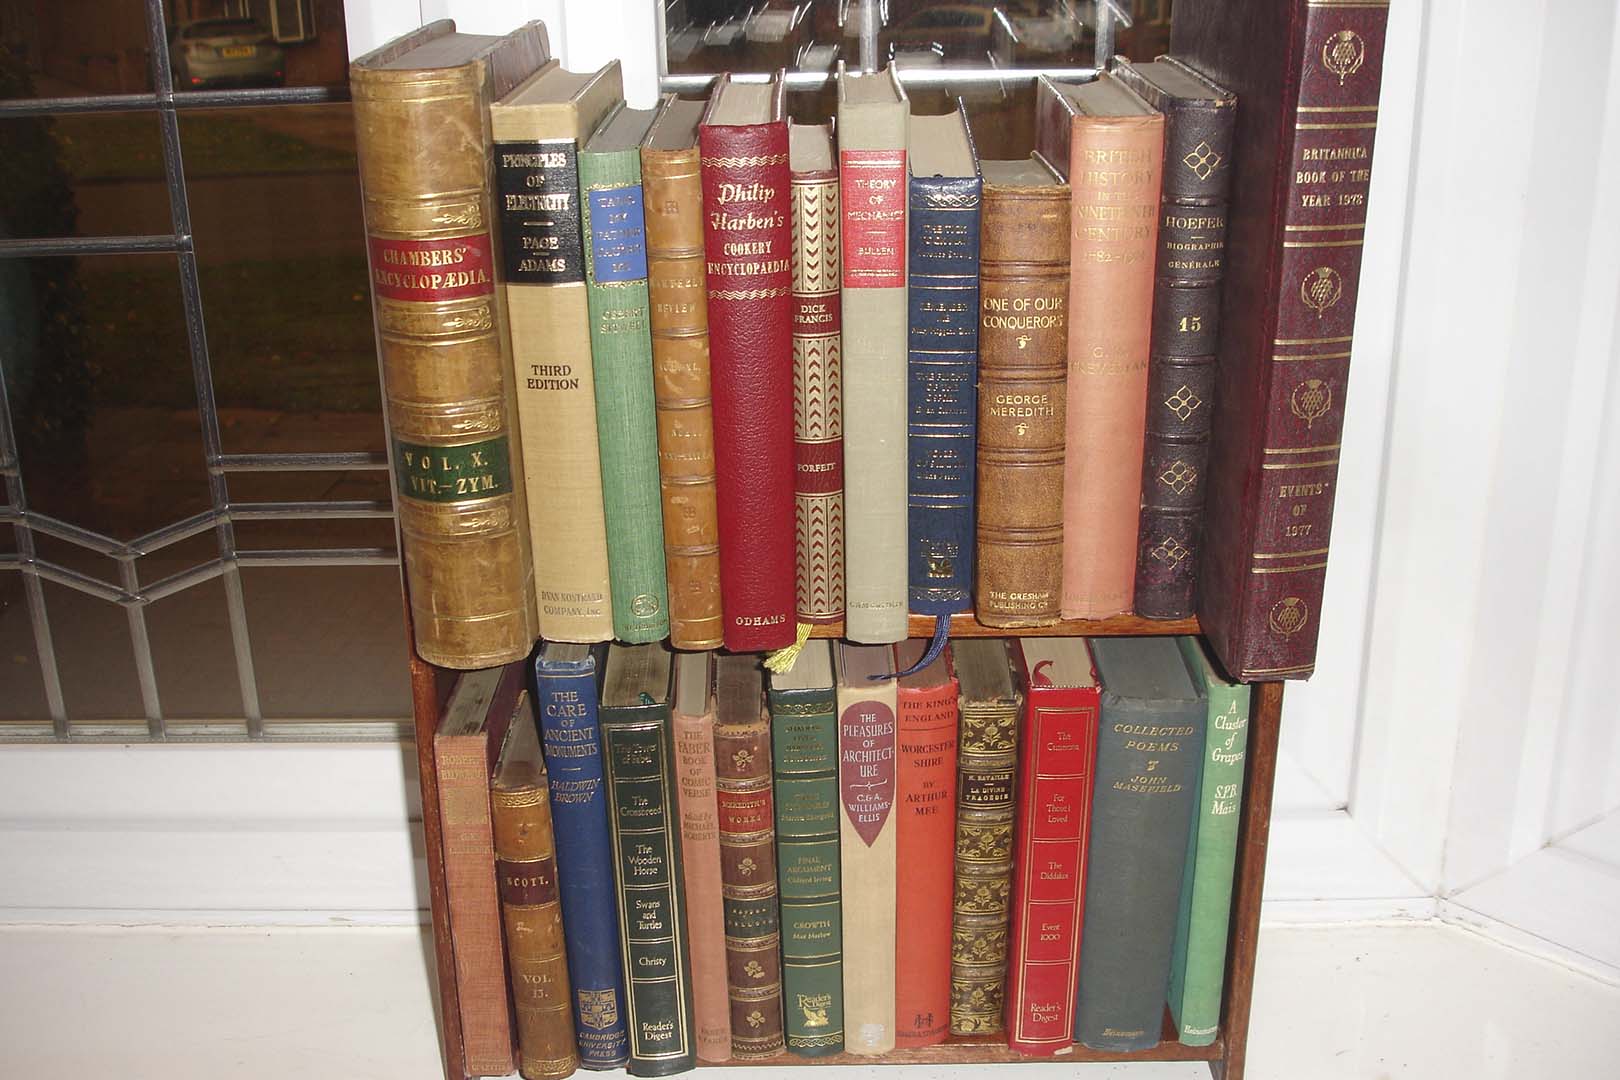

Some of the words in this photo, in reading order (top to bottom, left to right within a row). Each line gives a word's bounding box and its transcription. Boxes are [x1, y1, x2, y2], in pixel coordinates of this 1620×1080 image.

[1303, 147, 1368, 161] BRITANNICA
[502, 153, 567, 168] PRINCIPLES
[526, 175, 545, 188] OF
[1296, 170, 1327, 184] BOOK
[1331, 170, 1345, 183] OF
[1350, 169, 1369, 182] THE
[855, 179, 897, 189] THEORY
[717, 183, 774, 204] Philip
[505, 193, 570, 211] ELECTRICITY
[868, 195, 884, 205] OF
[1302, 194, 1331, 207] YEAR
[1338, 193, 1363, 206] 1978
[711, 210, 784, 231] Harben's
[848, 210, 905, 221] MECHANICS
[1166, 216, 1224, 230] HOEFER
[522, 237, 559, 250] PAGE
[724, 240, 772, 256] COOKERY
[383, 248, 469, 267] CHAMBERS'
[518, 259, 566, 272] ADAMS
[707, 259, 790, 276] ENCYCLOPAEDIA
[801, 304, 826, 313] DICK
[984, 297, 1009, 312] ONE
[1013, 298, 1031, 312] OF
[1034, 297, 1063, 311] OUR
[795, 313, 833, 324] FRANCIS
[983, 314, 1063, 329] CONQUERORS
[1179, 316, 1201, 332] 15
[531, 364, 572, 377] THIRD
[527, 378, 579, 390] EDITION
[996, 394, 1048, 405] GEORGE
[990, 406, 1054, 417] MEREDITH
[471, 450, 488, 468] X.
[797, 462, 836, 472] FORFEIT
[1292, 504, 1307, 517] OF
[1285, 524, 1312, 537] 1977
[989, 591, 1007, 600] THE
[1010, 591, 1049, 600] GRESHAM
[989, 601, 1036, 610] PUBLISHING
[736, 614, 786, 627] ODHAMS
[552, 691, 579, 703] THE
[546, 703, 588, 718] CARE
[903, 701, 922, 710] THE
[1228, 699, 1238, 714] A
[860, 713, 876, 723] THE
[905, 711, 954, 723] ENGLAND
[1214, 715, 1248, 731] Cluster
[561, 719, 575, 728] OF
[544, 727, 594, 743] ANCIENT
[843, 722, 894, 738] PLEASURES
[1113, 723, 1194, 737] COLLECTED
[862, 740, 876, 748] OF
[901, 740, 955, 754] WORCESTER
[1125, 740, 1180, 752] POEMS
[1224, 732, 1238, 750] of
[545, 743, 598, 758] MONUMENTS
[679, 743, 711, 754] FABER
[913, 757, 944, 768] SHIRE
[1211, 748, 1246, 766] Grapes
[859, 765, 879, 778] URE
[551, 777, 601, 791] BALDWIN
[923, 781, 934, 789] BY
[1130, 775, 1168, 784] JOHN
[683, 788, 710, 798] VERSE
[1113, 781, 1183, 793] MASEFIELD
[555, 791, 595, 803] BROWN
[905, 791, 948, 803] ARTHUR
[1053, 793, 1065, 802] For
[914, 806, 938, 816] MEE
[1211, 801, 1237, 815] Mais
[858, 813, 880, 823] ELLIS
[1047, 815, 1068, 824] Loved
[635, 844, 653, 854] The
[627, 855, 662, 865] Wooden
[1048, 862, 1063, 870] The
[634, 865, 658, 876] Horse
[636, 900, 661, 910] Swans
[642, 910, 656, 920] and
[636, 920, 662, 930] Turtles
[1041, 923, 1060, 932] Event
[1040, 932, 1061, 941] 1000
[639, 956, 667, 967] Christy
[1031, 1002, 1061, 1013] Reader's
[1032, 1012, 1059, 1024] Digest
[642, 1021, 674, 1032] Reader's
[580, 1030, 625, 1041] CAMBRIDGE
[644, 1031, 673, 1042] Digest
[579, 1038, 627, 1050] UNIVERSITY
[588, 1048, 617, 1057] PRESS
